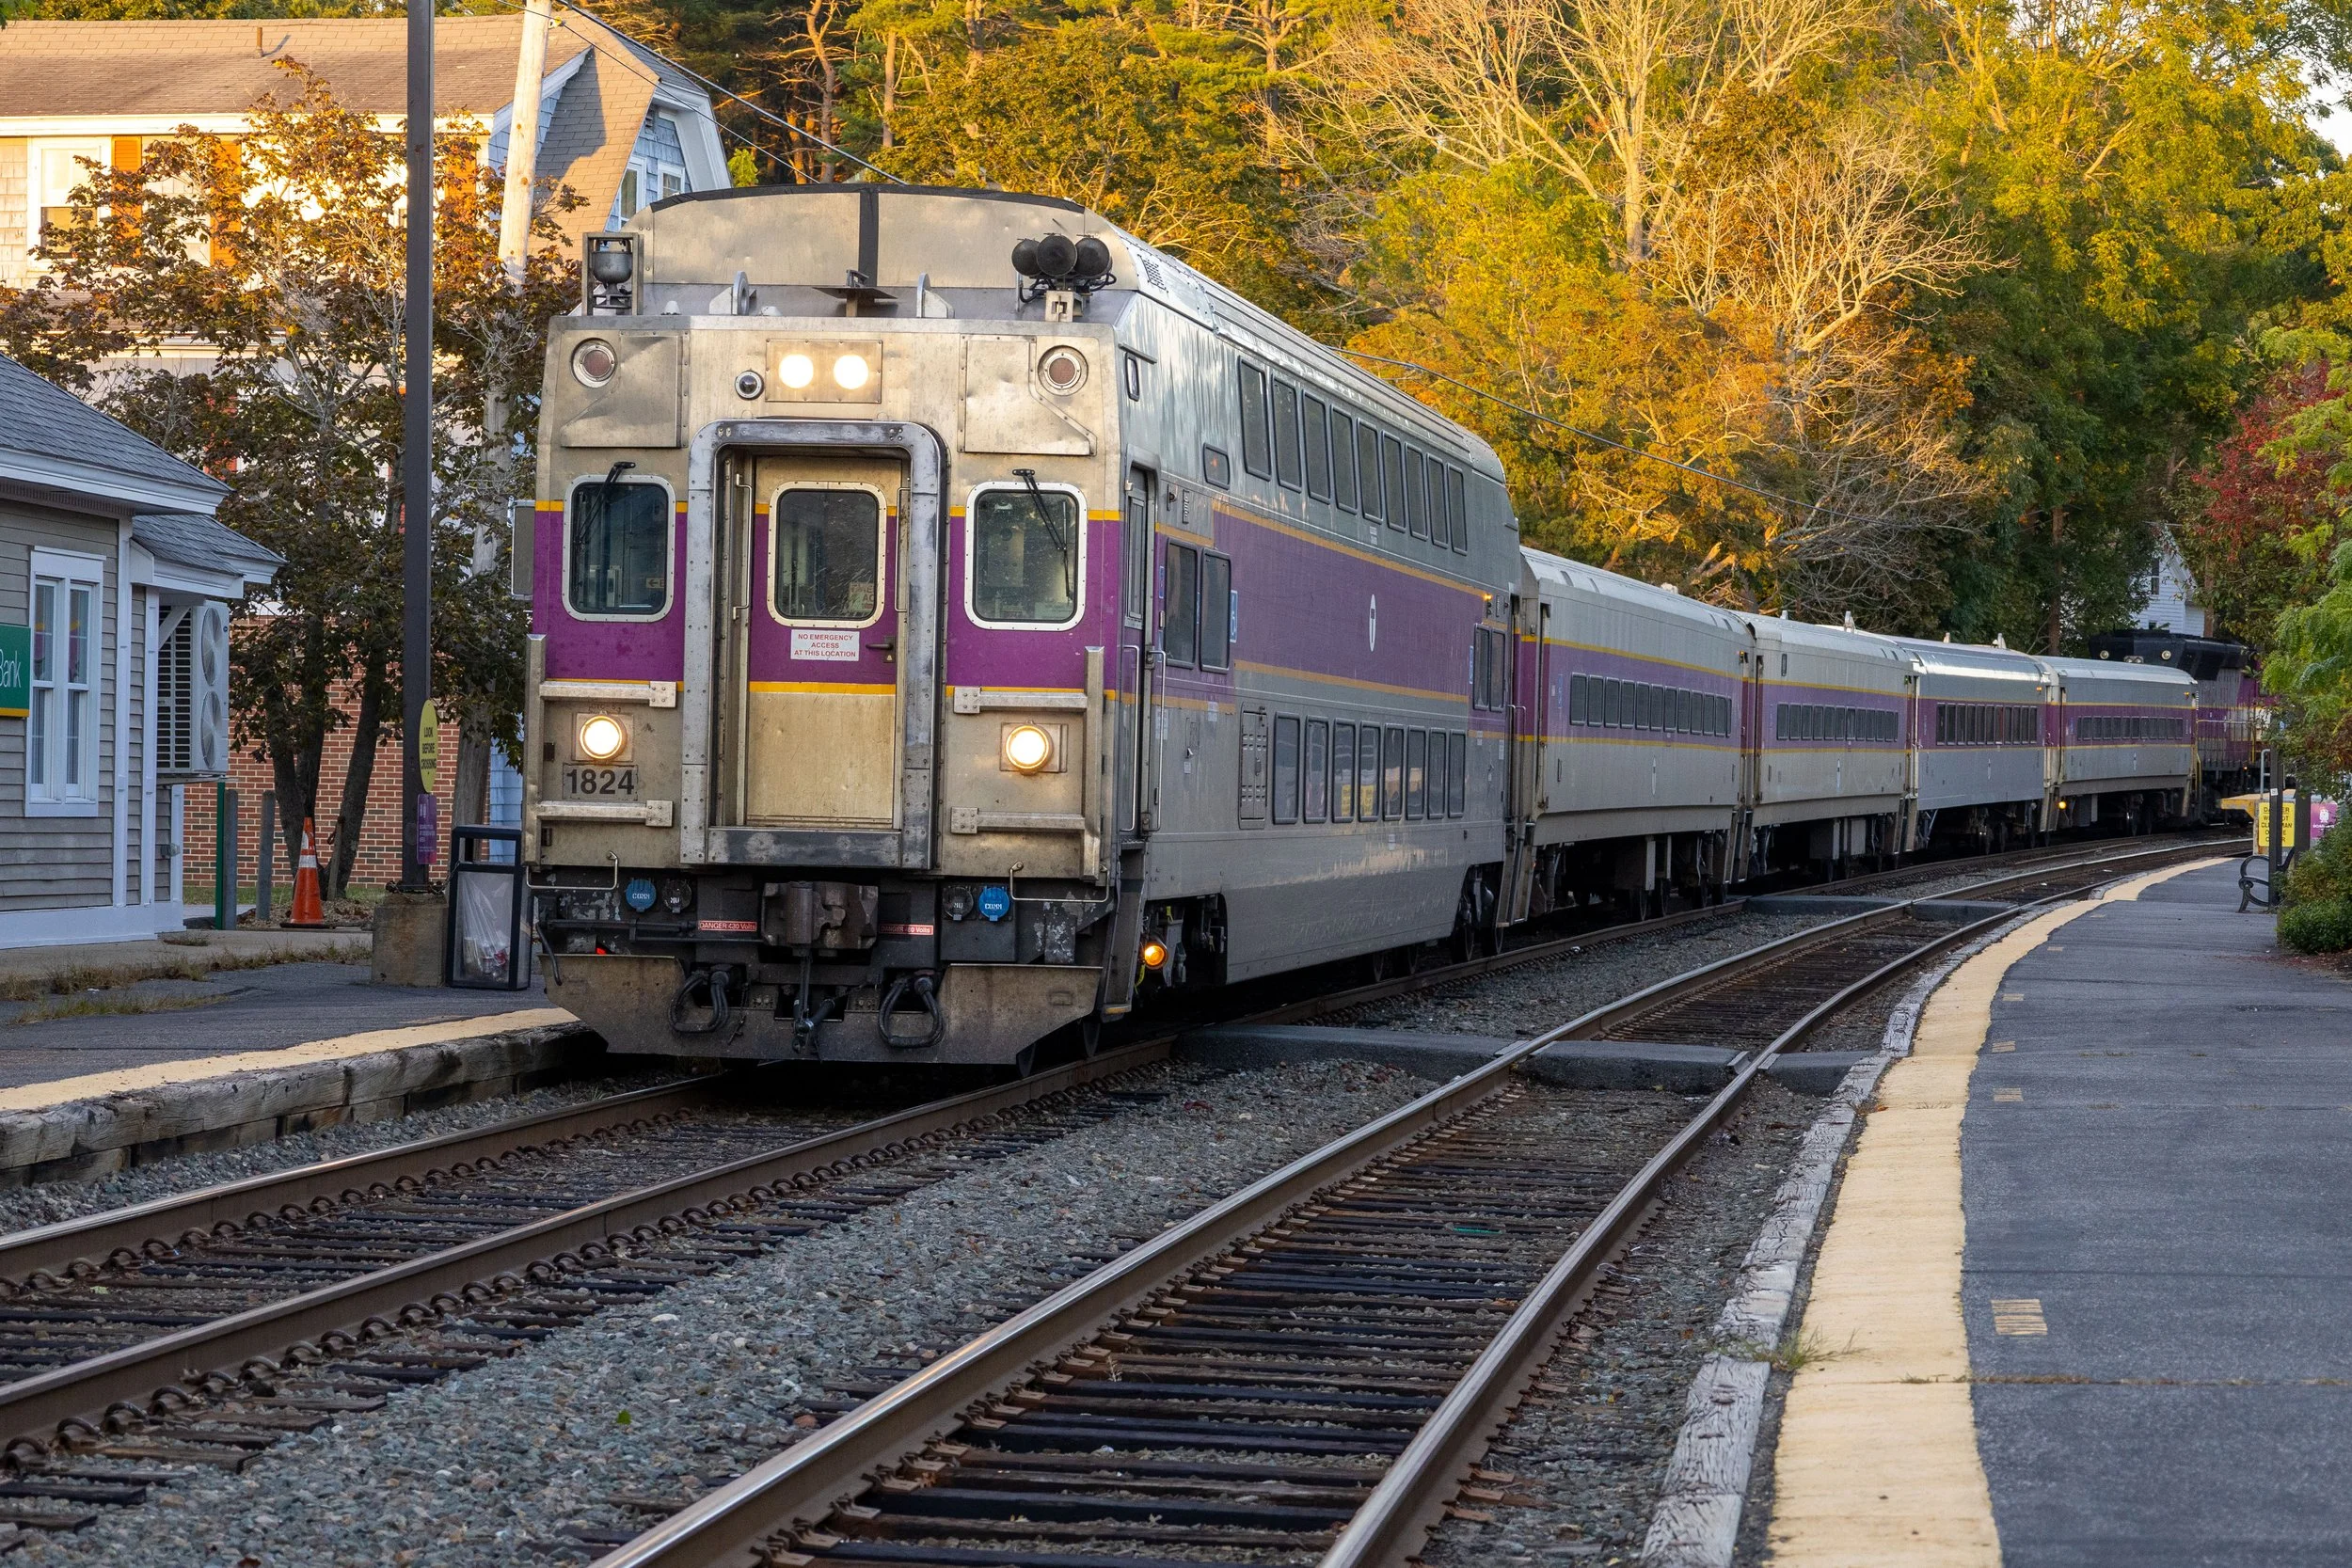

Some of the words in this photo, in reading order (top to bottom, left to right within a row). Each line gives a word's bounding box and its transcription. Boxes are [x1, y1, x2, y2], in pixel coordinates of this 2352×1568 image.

[423, 726, 433, 737] LOOK
[421, 743, 435, 753] BEFORE
[421, 758, 437, 769] CROSSING
[566, 768, 634, 795] 1824
